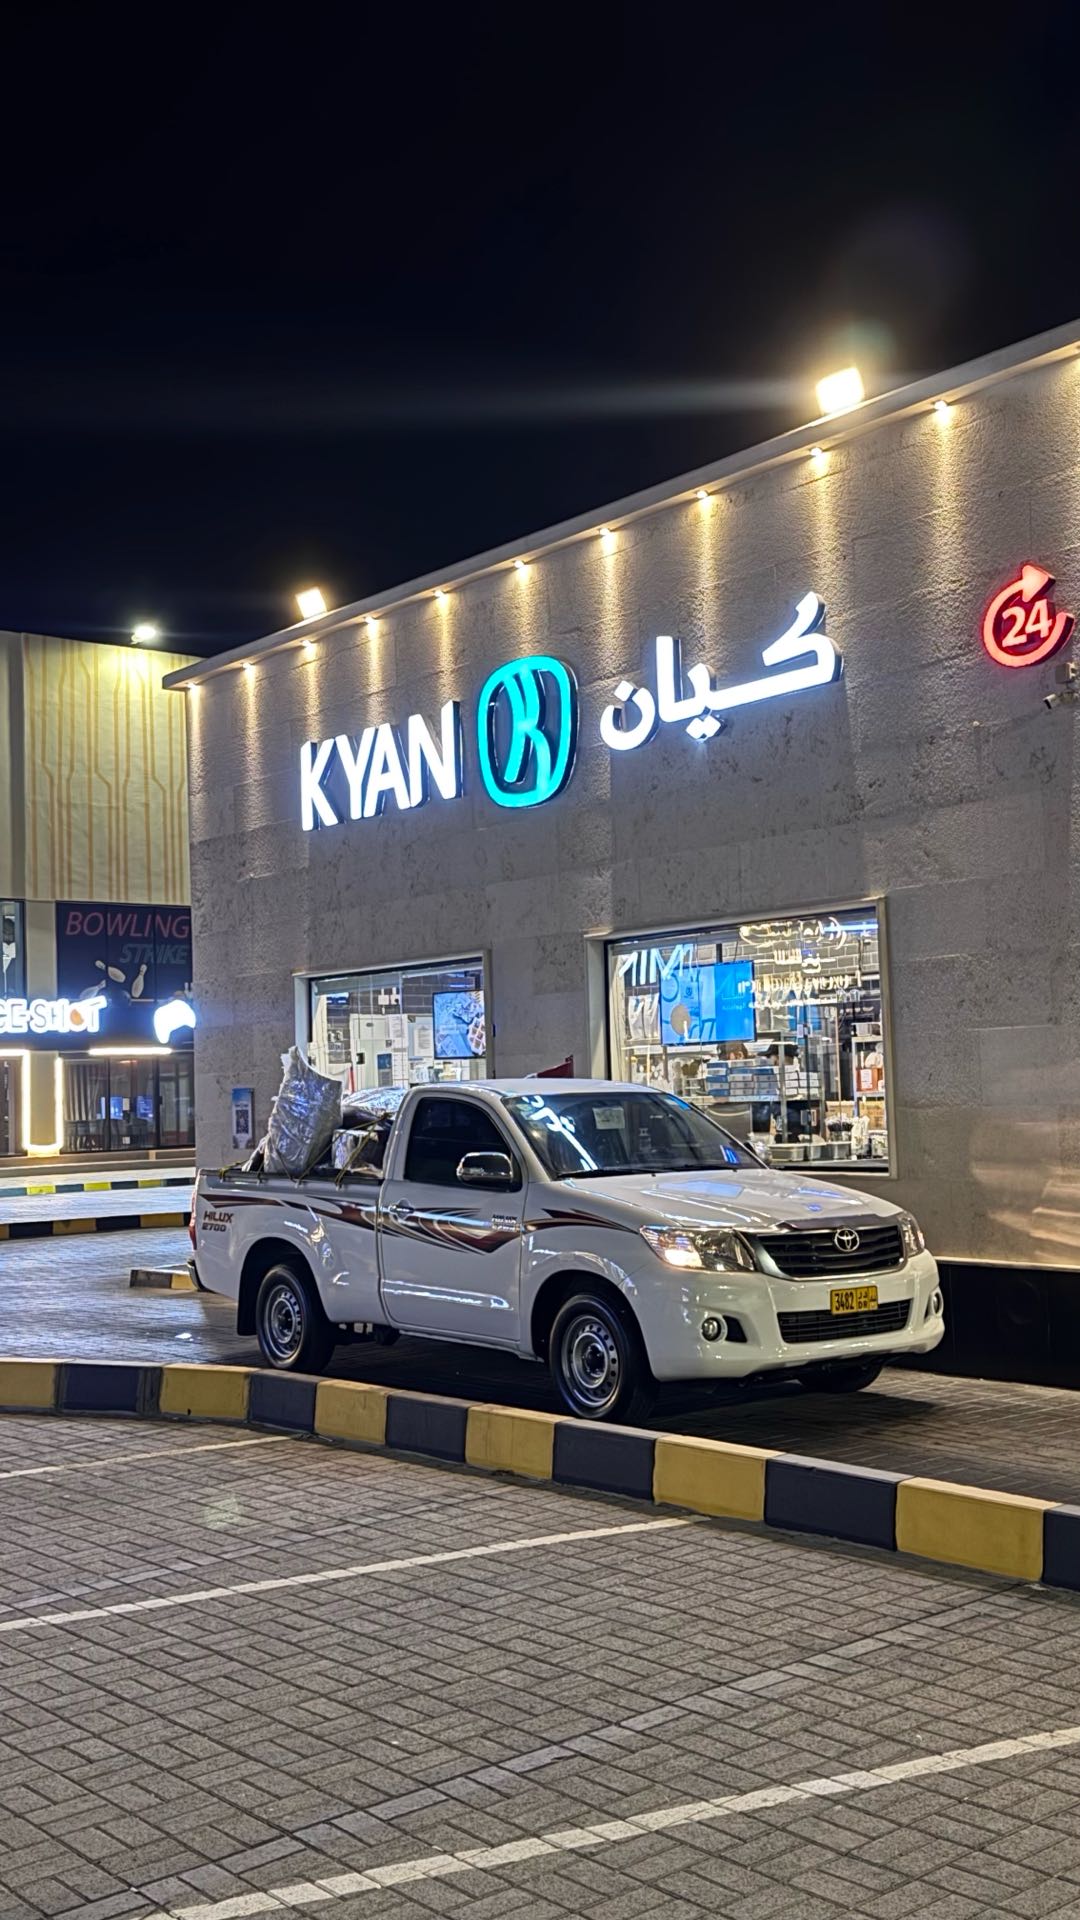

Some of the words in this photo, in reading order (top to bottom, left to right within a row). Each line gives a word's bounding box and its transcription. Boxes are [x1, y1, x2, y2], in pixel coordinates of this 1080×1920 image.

[1002, 598, 1053, 648] 24
[600, 591, 844, 750] كيان
[301, 701, 460, 831] KYAN
[65, 911, 190, 939] BOWLING
[119, 943, 190, 965] STRIKE
[834, 1291, 855, 1311] 3482
